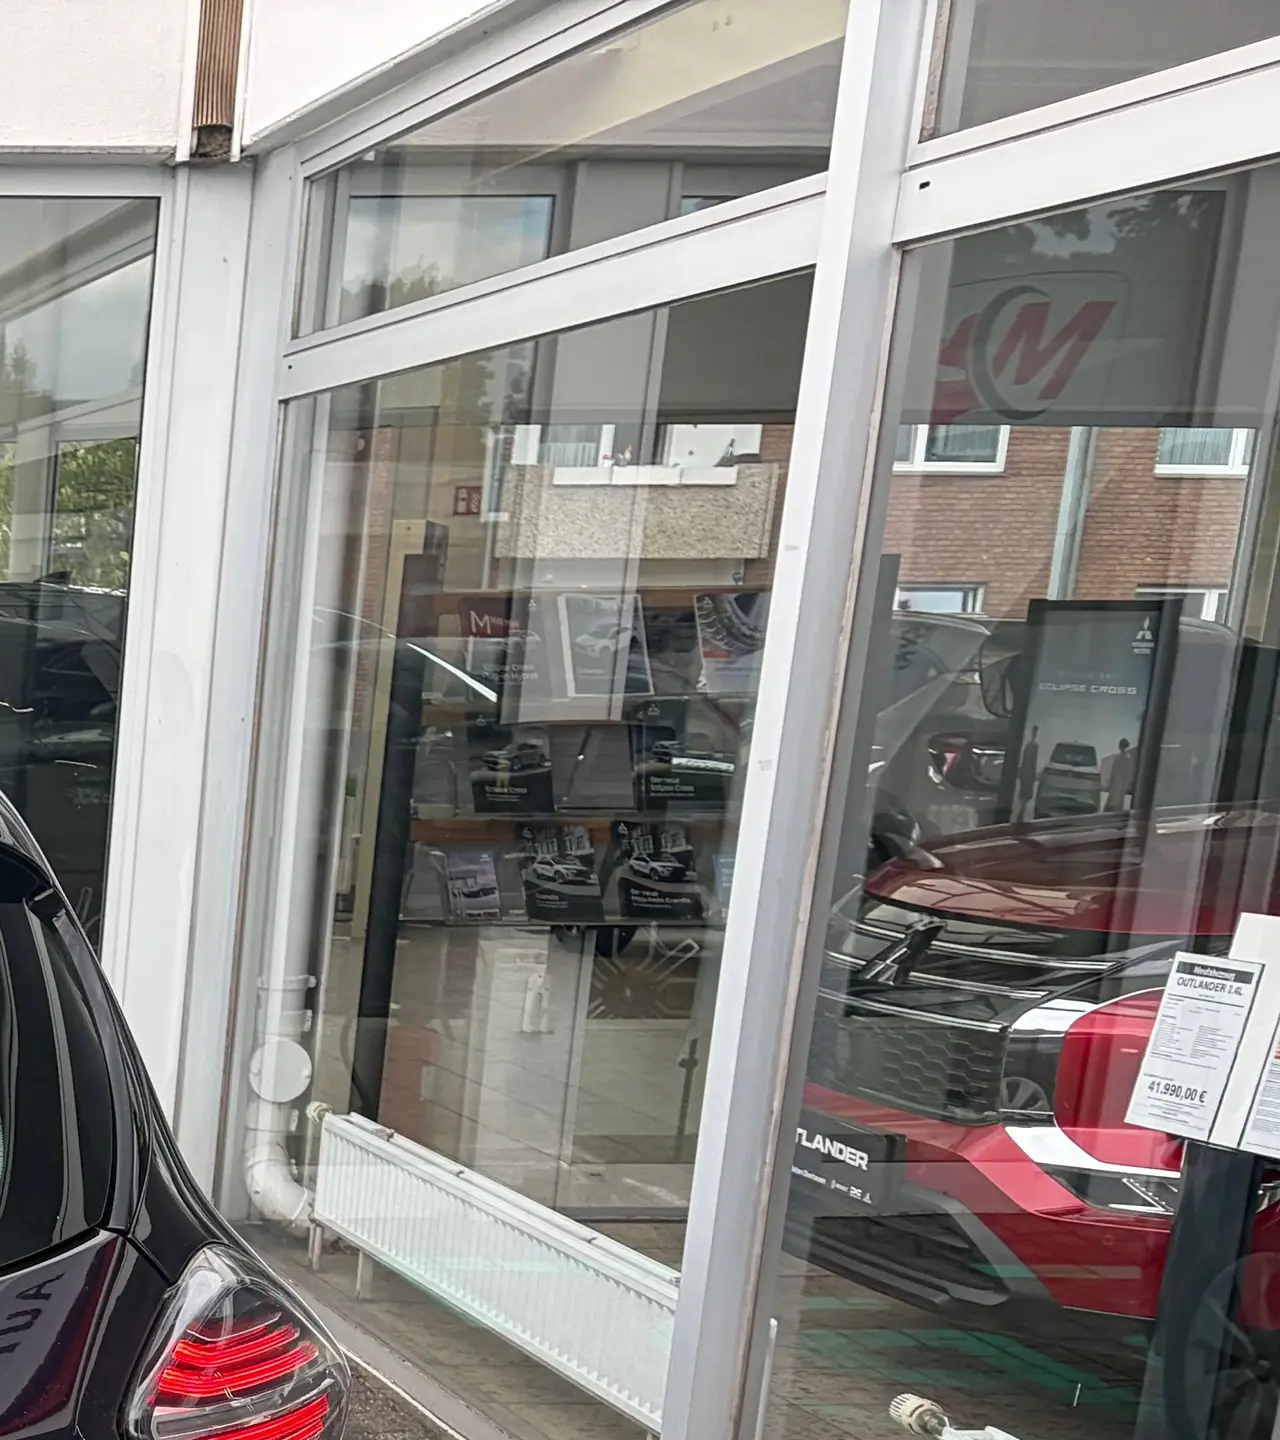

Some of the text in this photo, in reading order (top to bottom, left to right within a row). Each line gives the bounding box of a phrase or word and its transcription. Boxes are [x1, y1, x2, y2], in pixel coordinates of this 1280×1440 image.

[1090, 684, 1137, 695] CROSS
[1176, 976, 1227, 993] OUTLANDER
[1147, 1080, 1208, 1104] 41.990,00 €
